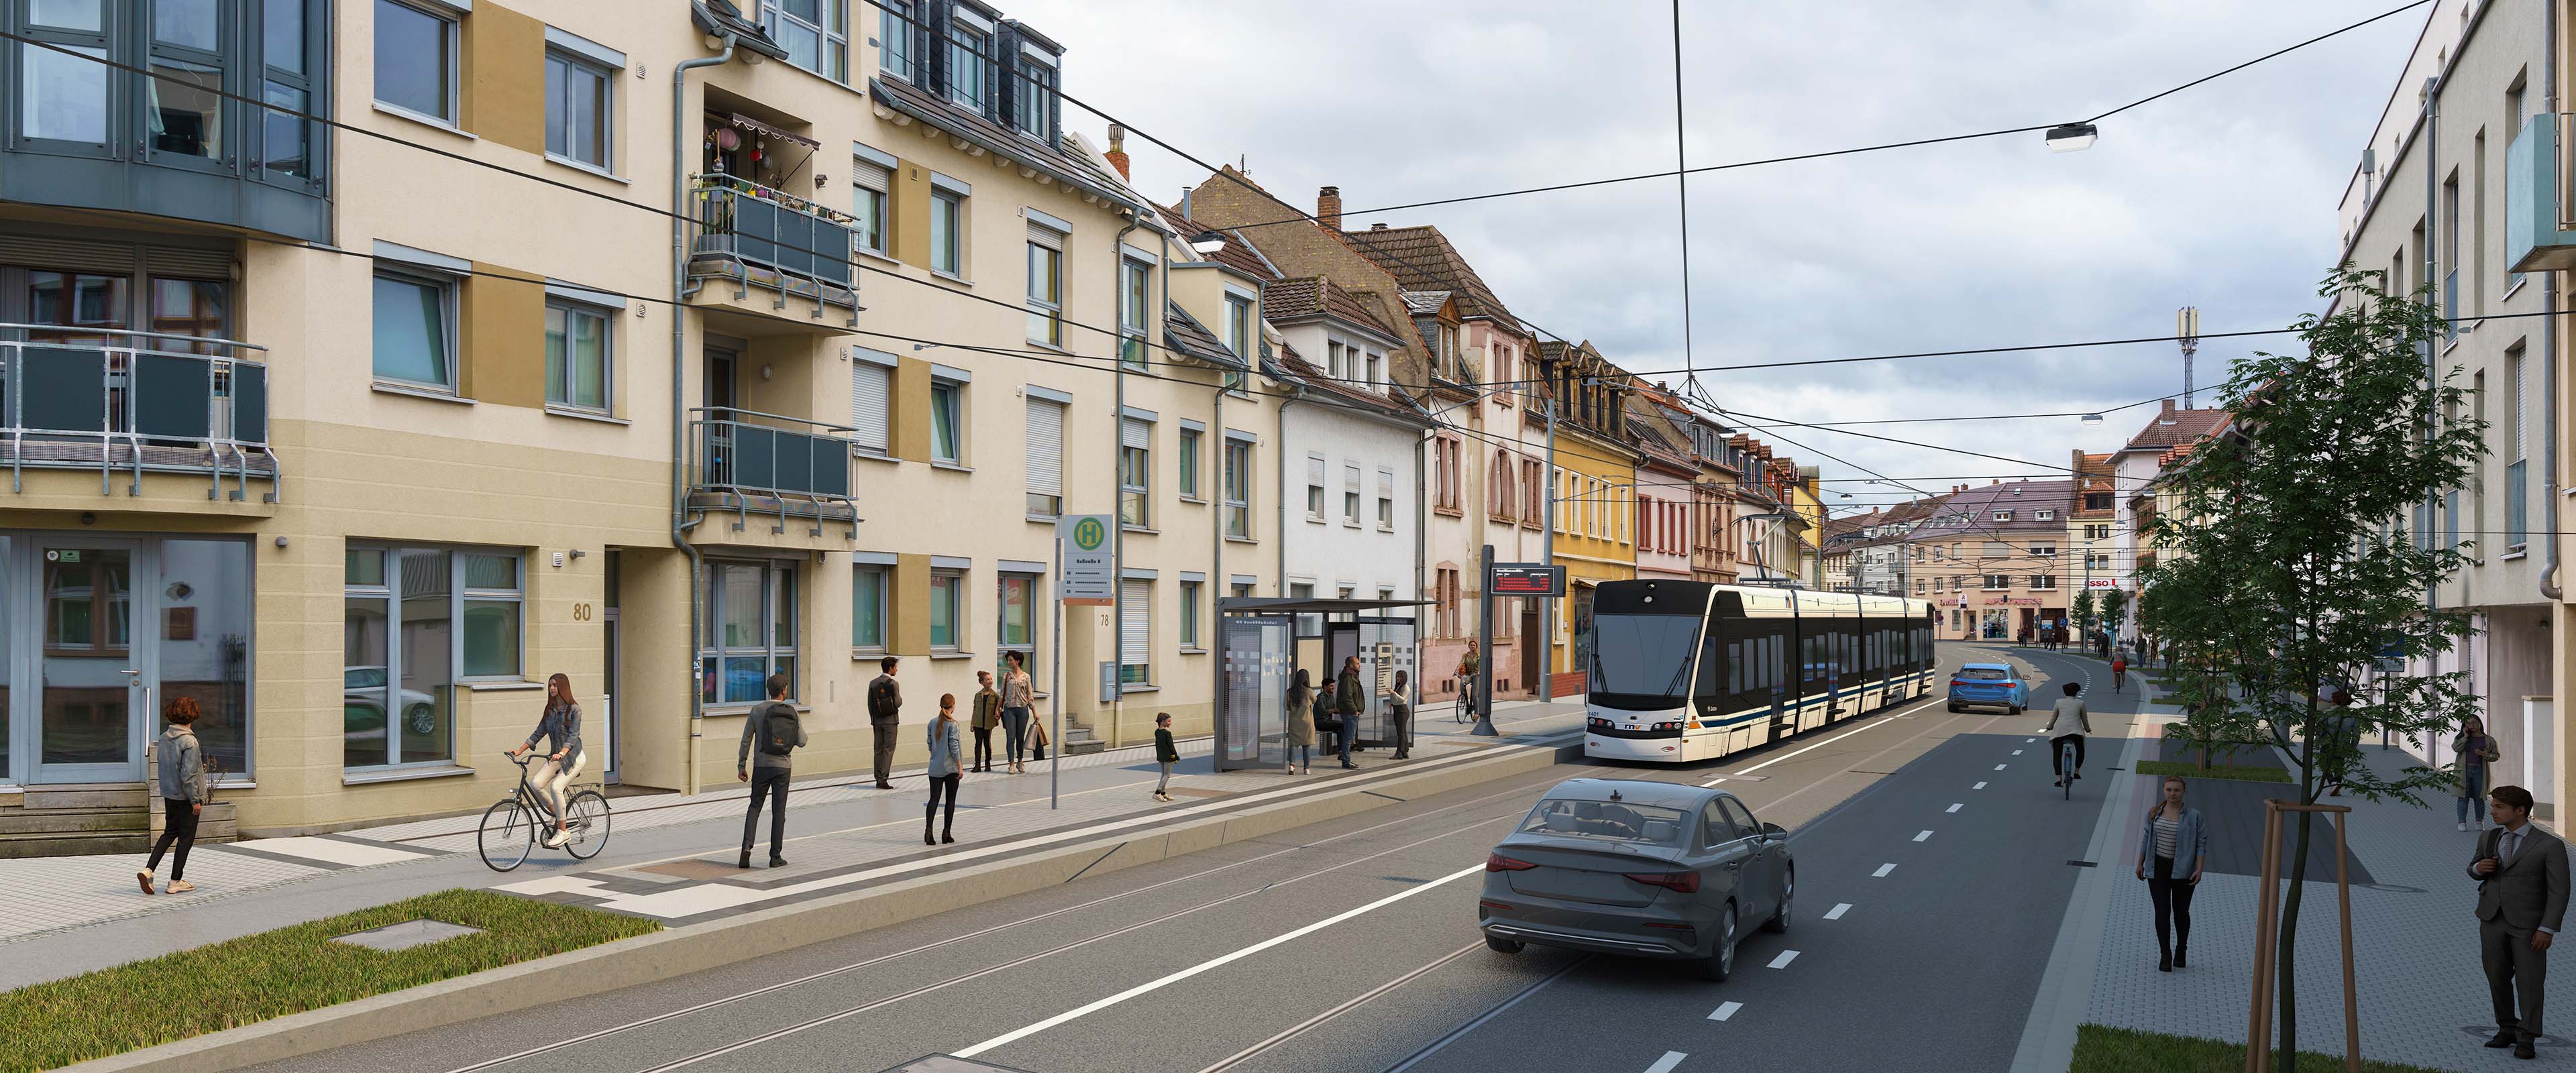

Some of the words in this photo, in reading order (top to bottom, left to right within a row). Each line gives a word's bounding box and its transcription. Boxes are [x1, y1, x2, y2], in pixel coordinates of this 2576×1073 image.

[1082, 524, 1096, 543] H
[574, 603, 591, 621] 80
[1101, 614, 1109, 626] 78
